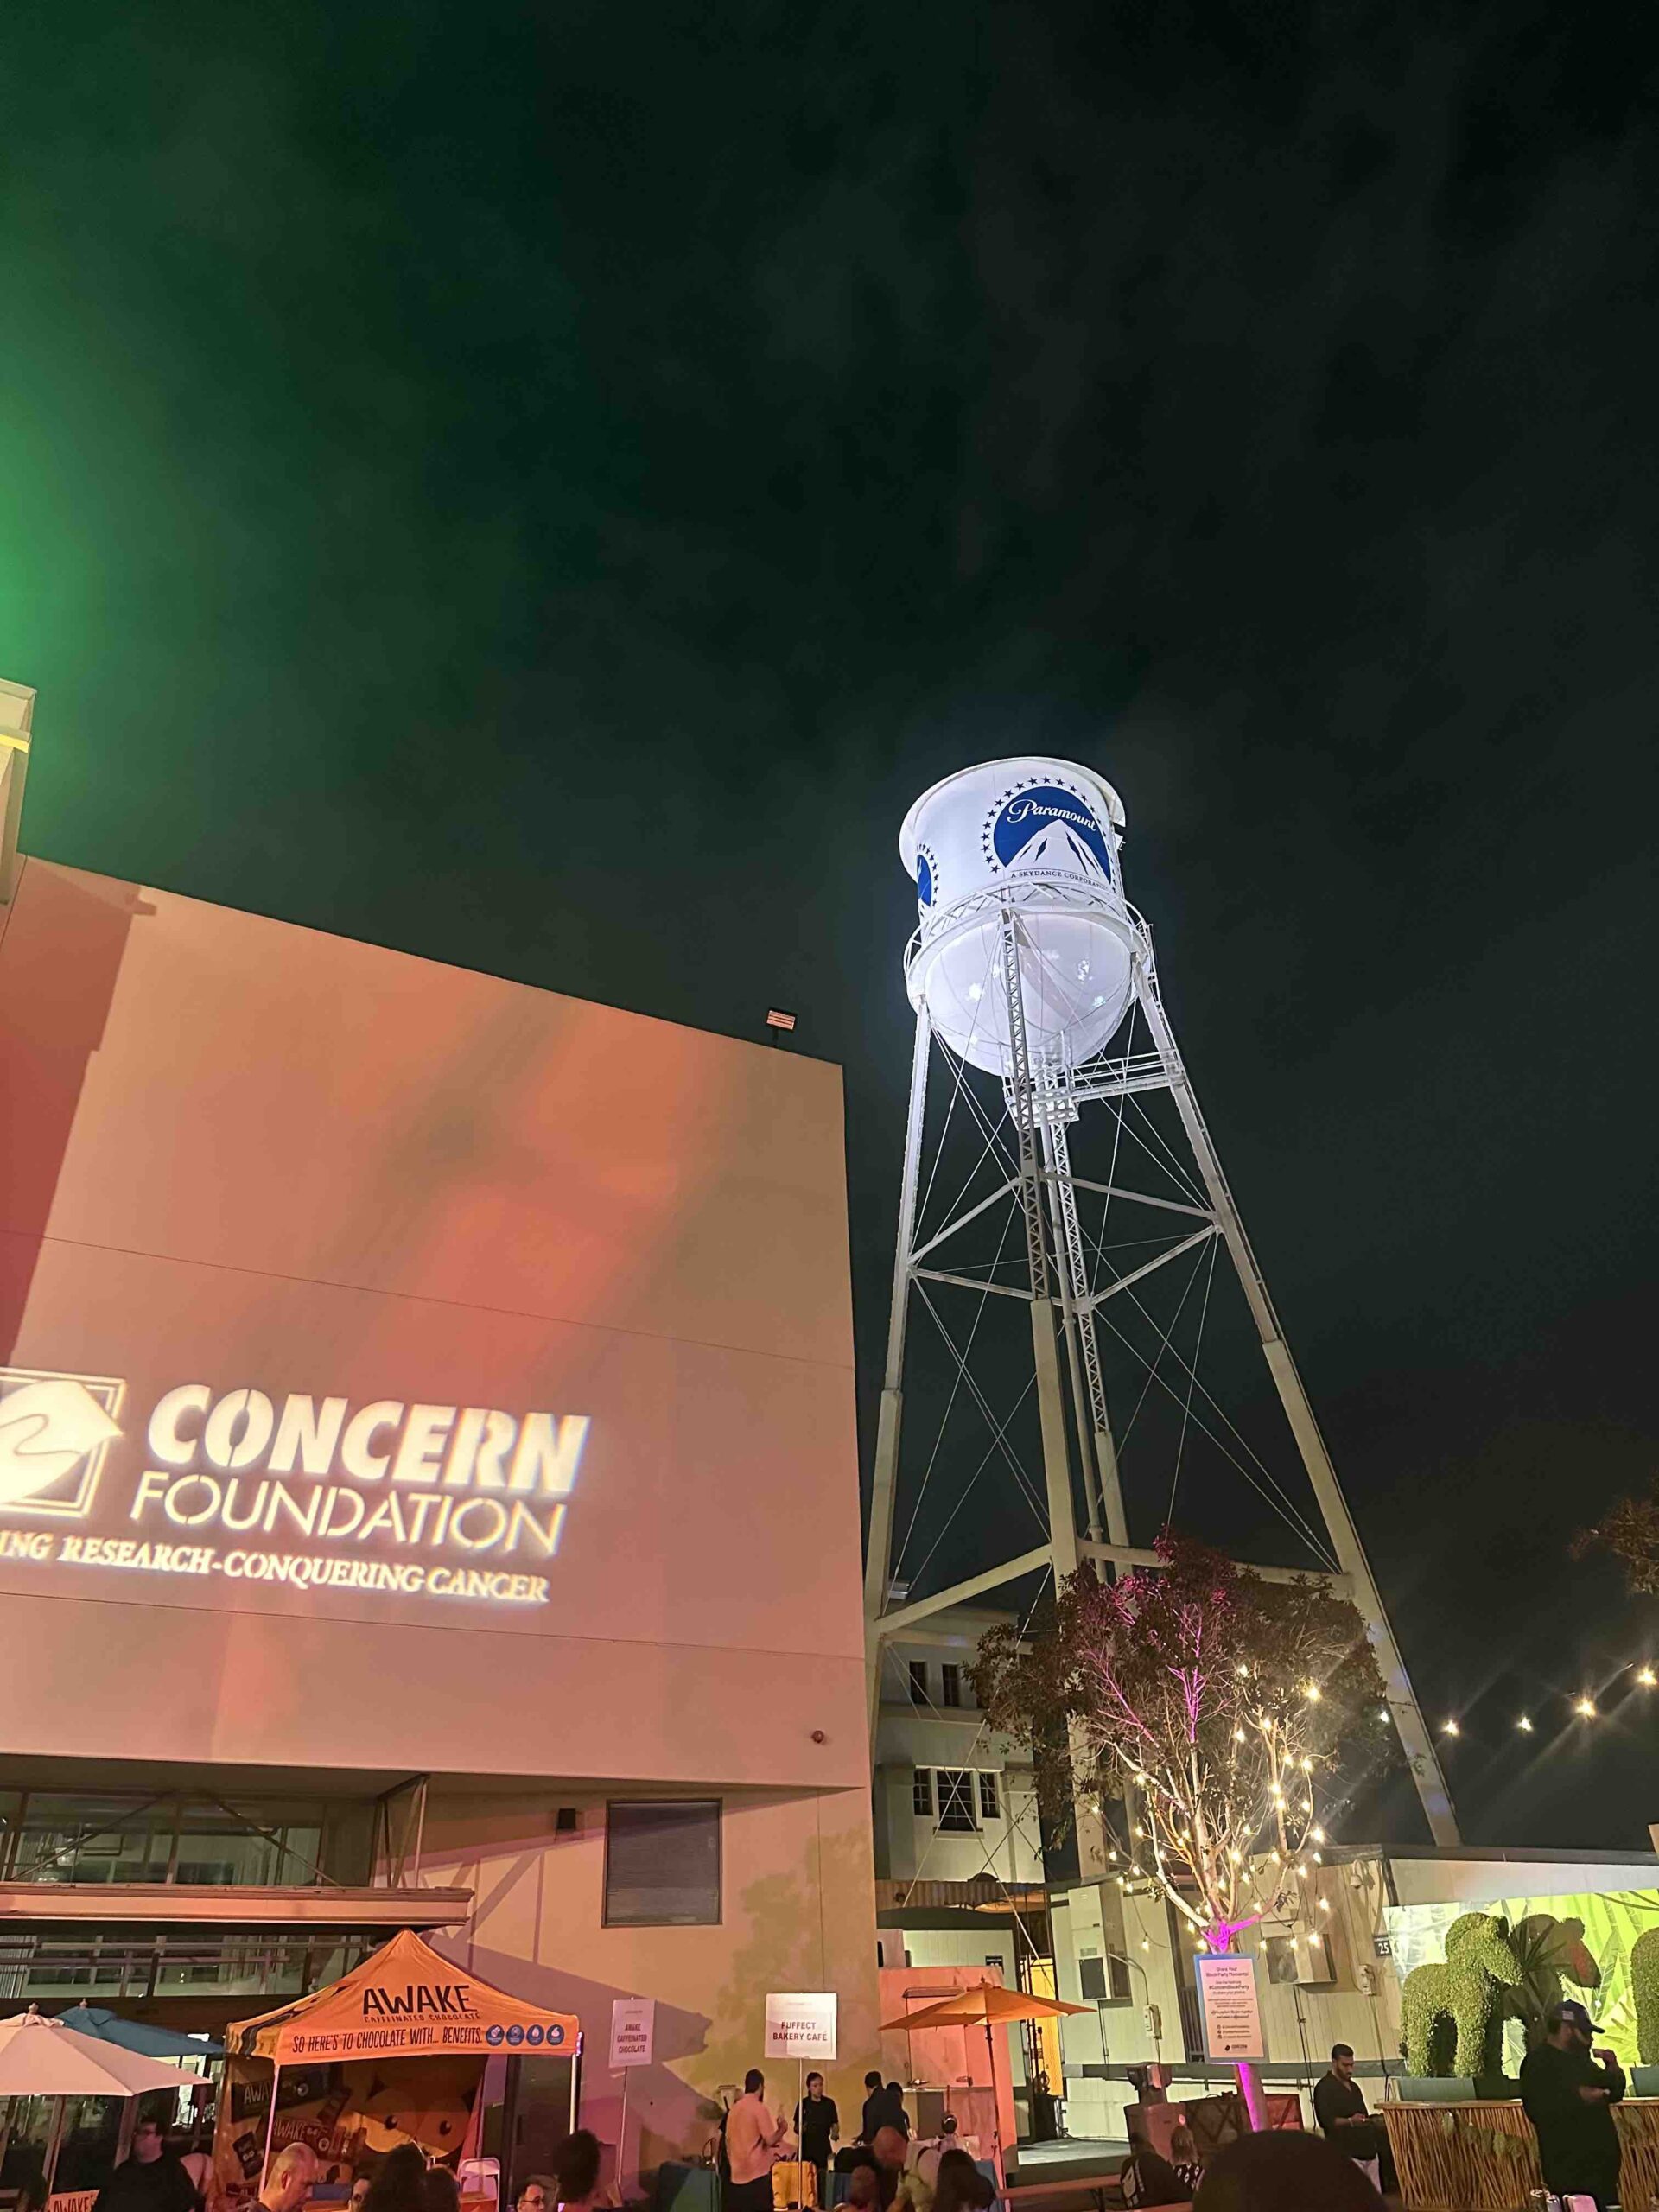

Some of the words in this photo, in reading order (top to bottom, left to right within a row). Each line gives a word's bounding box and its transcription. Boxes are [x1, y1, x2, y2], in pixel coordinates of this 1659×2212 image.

[1007, 799, 1096, 831] Paramount
[148, 1383, 591, 1493] CONCERN
[130, 1471, 567, 1555] FOUNDATION
[427, 1567, 550, 1602] CANCER
[1378, 1942, 1389, 1955] 25
[363, 1985, 477, 2015] AWAKE
[429, 2012, 481, 2021] CHOCOLATE
[781, 2021, 817, 2030] PUFFECT
[292, 2036, 305, 2053] SO
[308, 2034, 338, 2052] HERE'S
[342, 2033, 353, 2050] TO
[357, 2029, 406, 2049] CHOCOLATE
[442, 2026, 482, 2044] BENEFITS.
[617, 2034, 648, 2043] CAFFEINATED
[772, 2031, 804, 2041] BAKERY
[619, 2044, 645, 2054] CHOCOLATE
